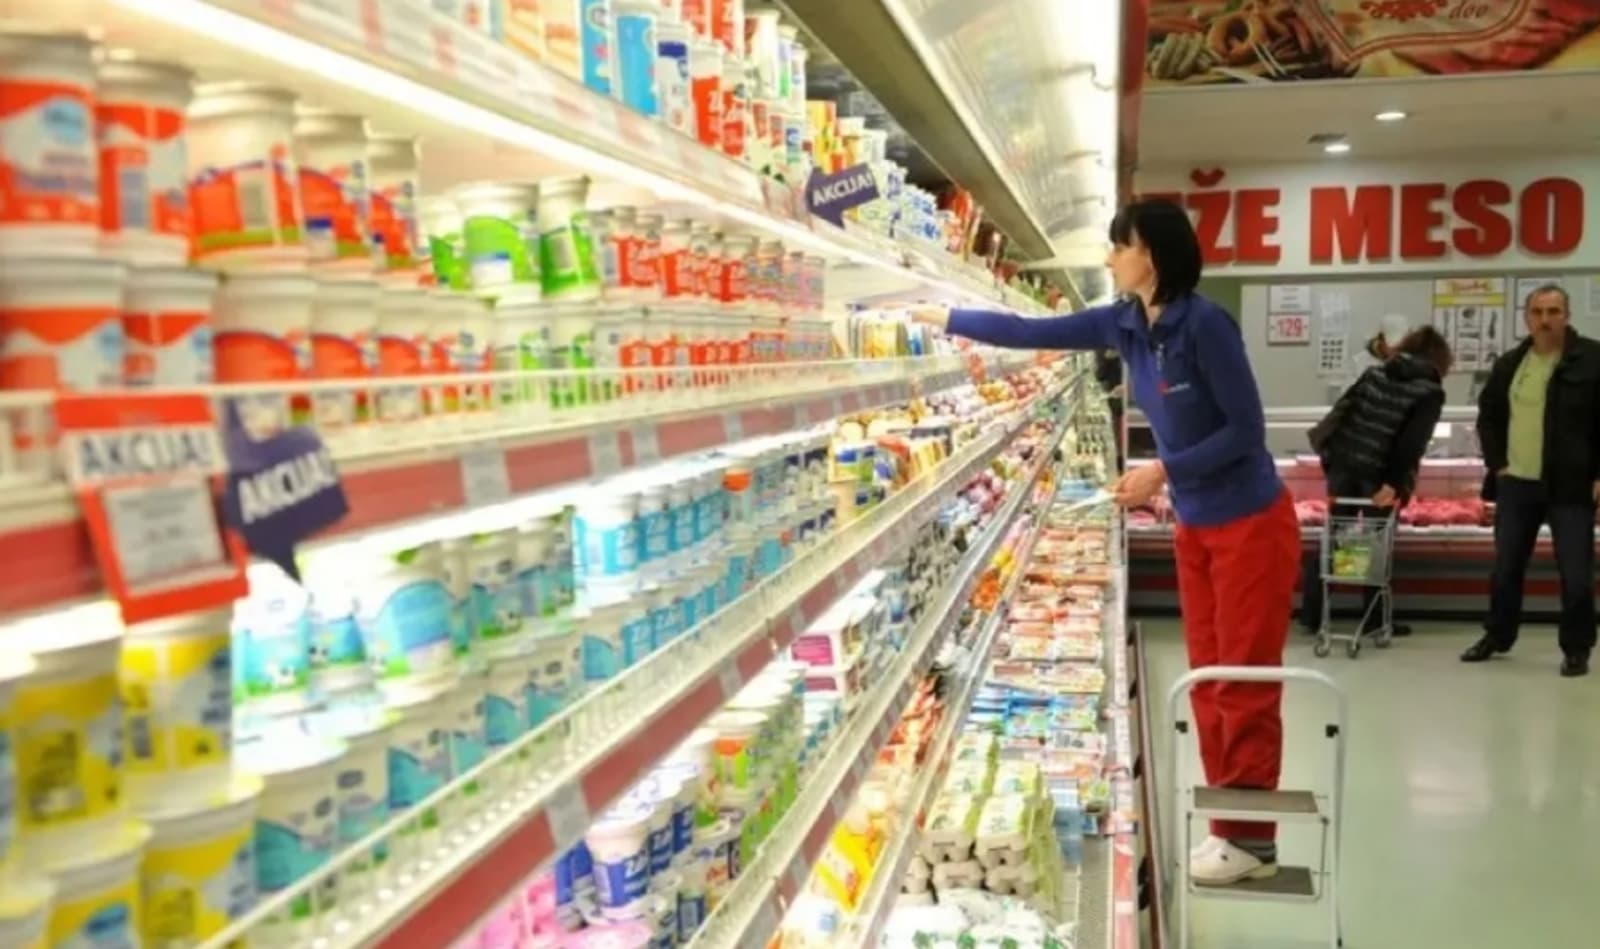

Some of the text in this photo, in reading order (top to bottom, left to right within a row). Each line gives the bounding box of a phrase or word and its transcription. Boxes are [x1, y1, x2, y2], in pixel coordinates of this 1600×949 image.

[812, 172, 874, 206] AKCIJA!
[1309, 177, 1585, 264] MESO
[238, 450, 338, 523] AKCIJA!
